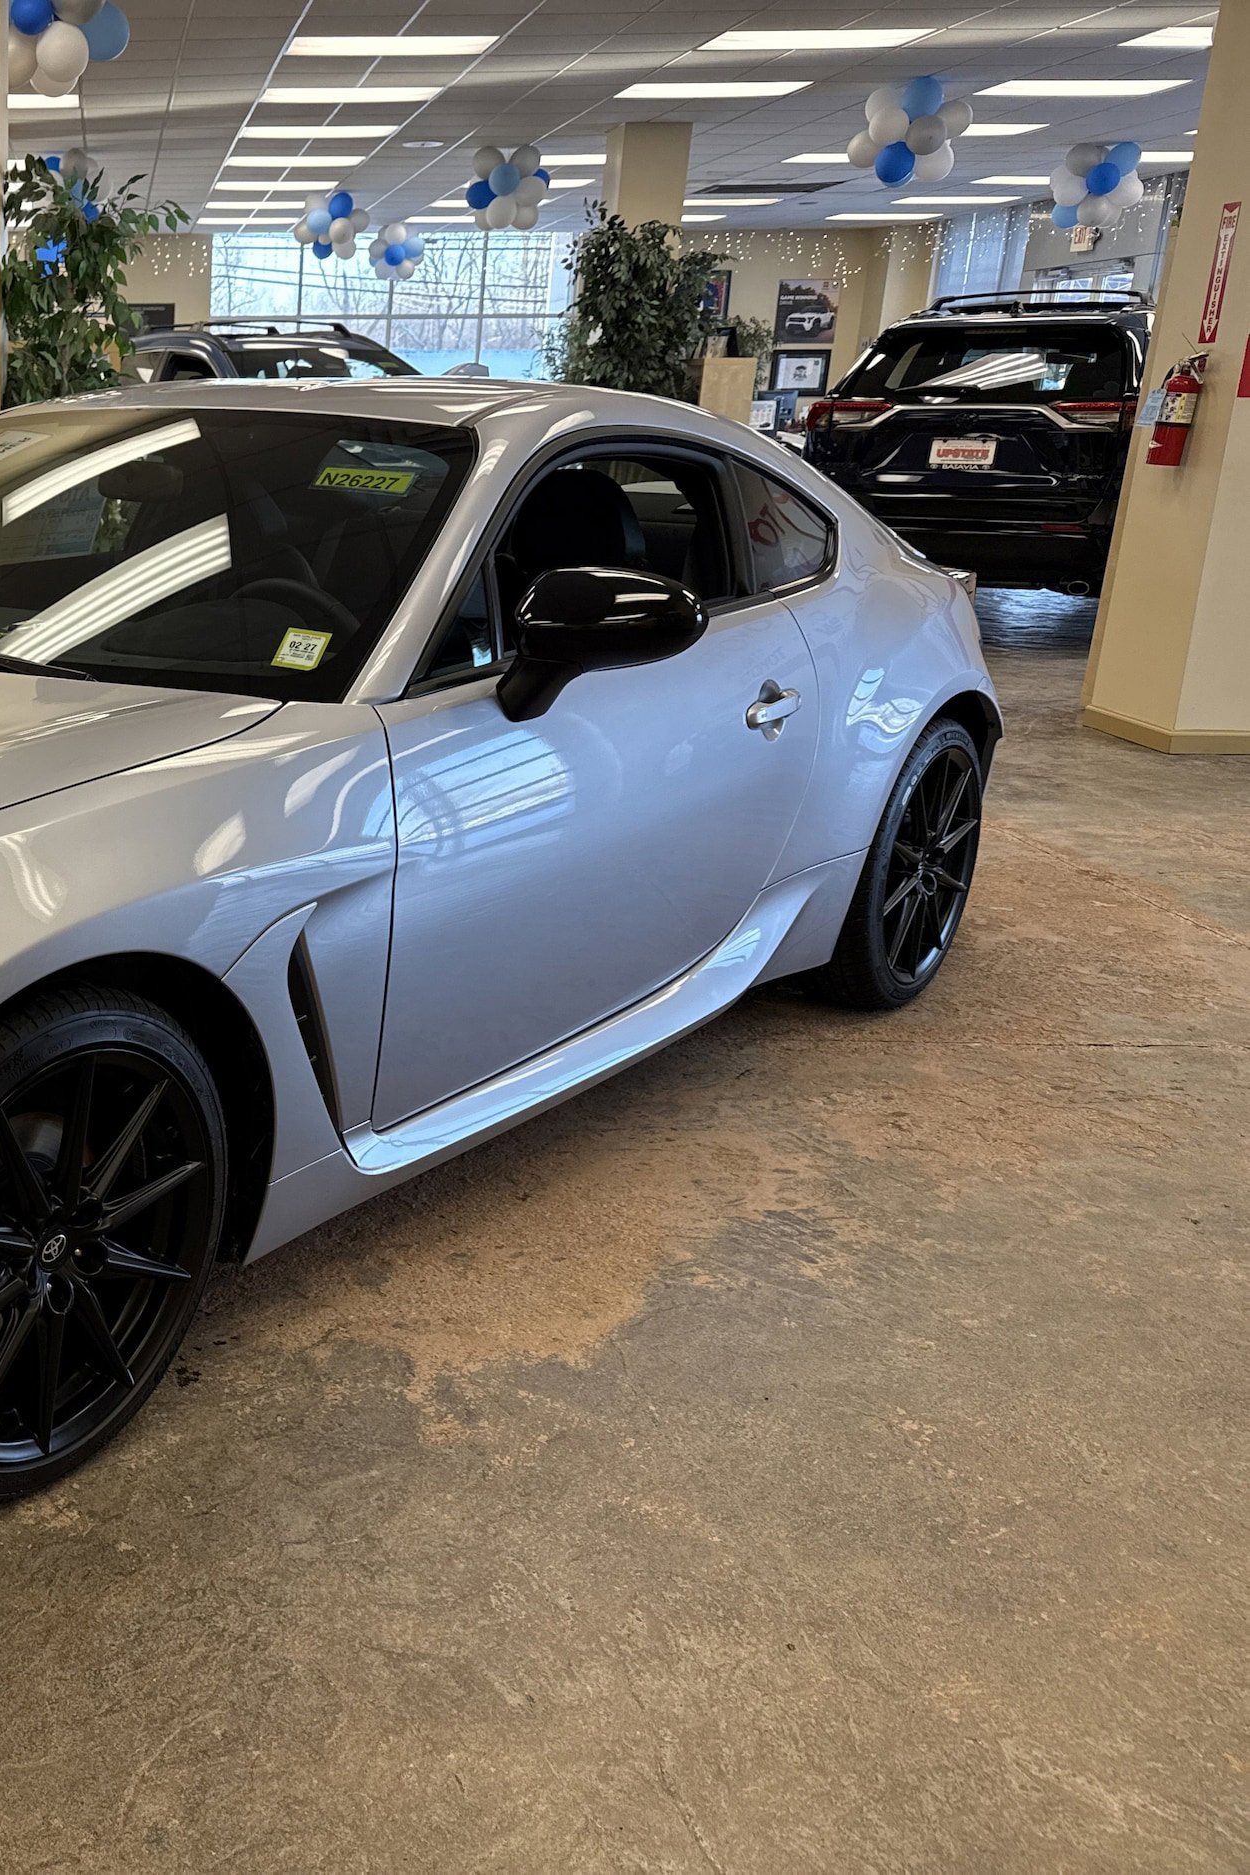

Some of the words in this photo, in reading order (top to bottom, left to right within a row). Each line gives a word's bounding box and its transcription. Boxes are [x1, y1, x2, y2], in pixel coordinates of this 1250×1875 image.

[1222, 215, 1237, 229] FIRE
[1206, 234, 1229, 333] EXTINGUISHER
[320, 472, 400, 490] N26227
[289, 640, 302, 649] 02
[303, 643, 318, 651] 27
